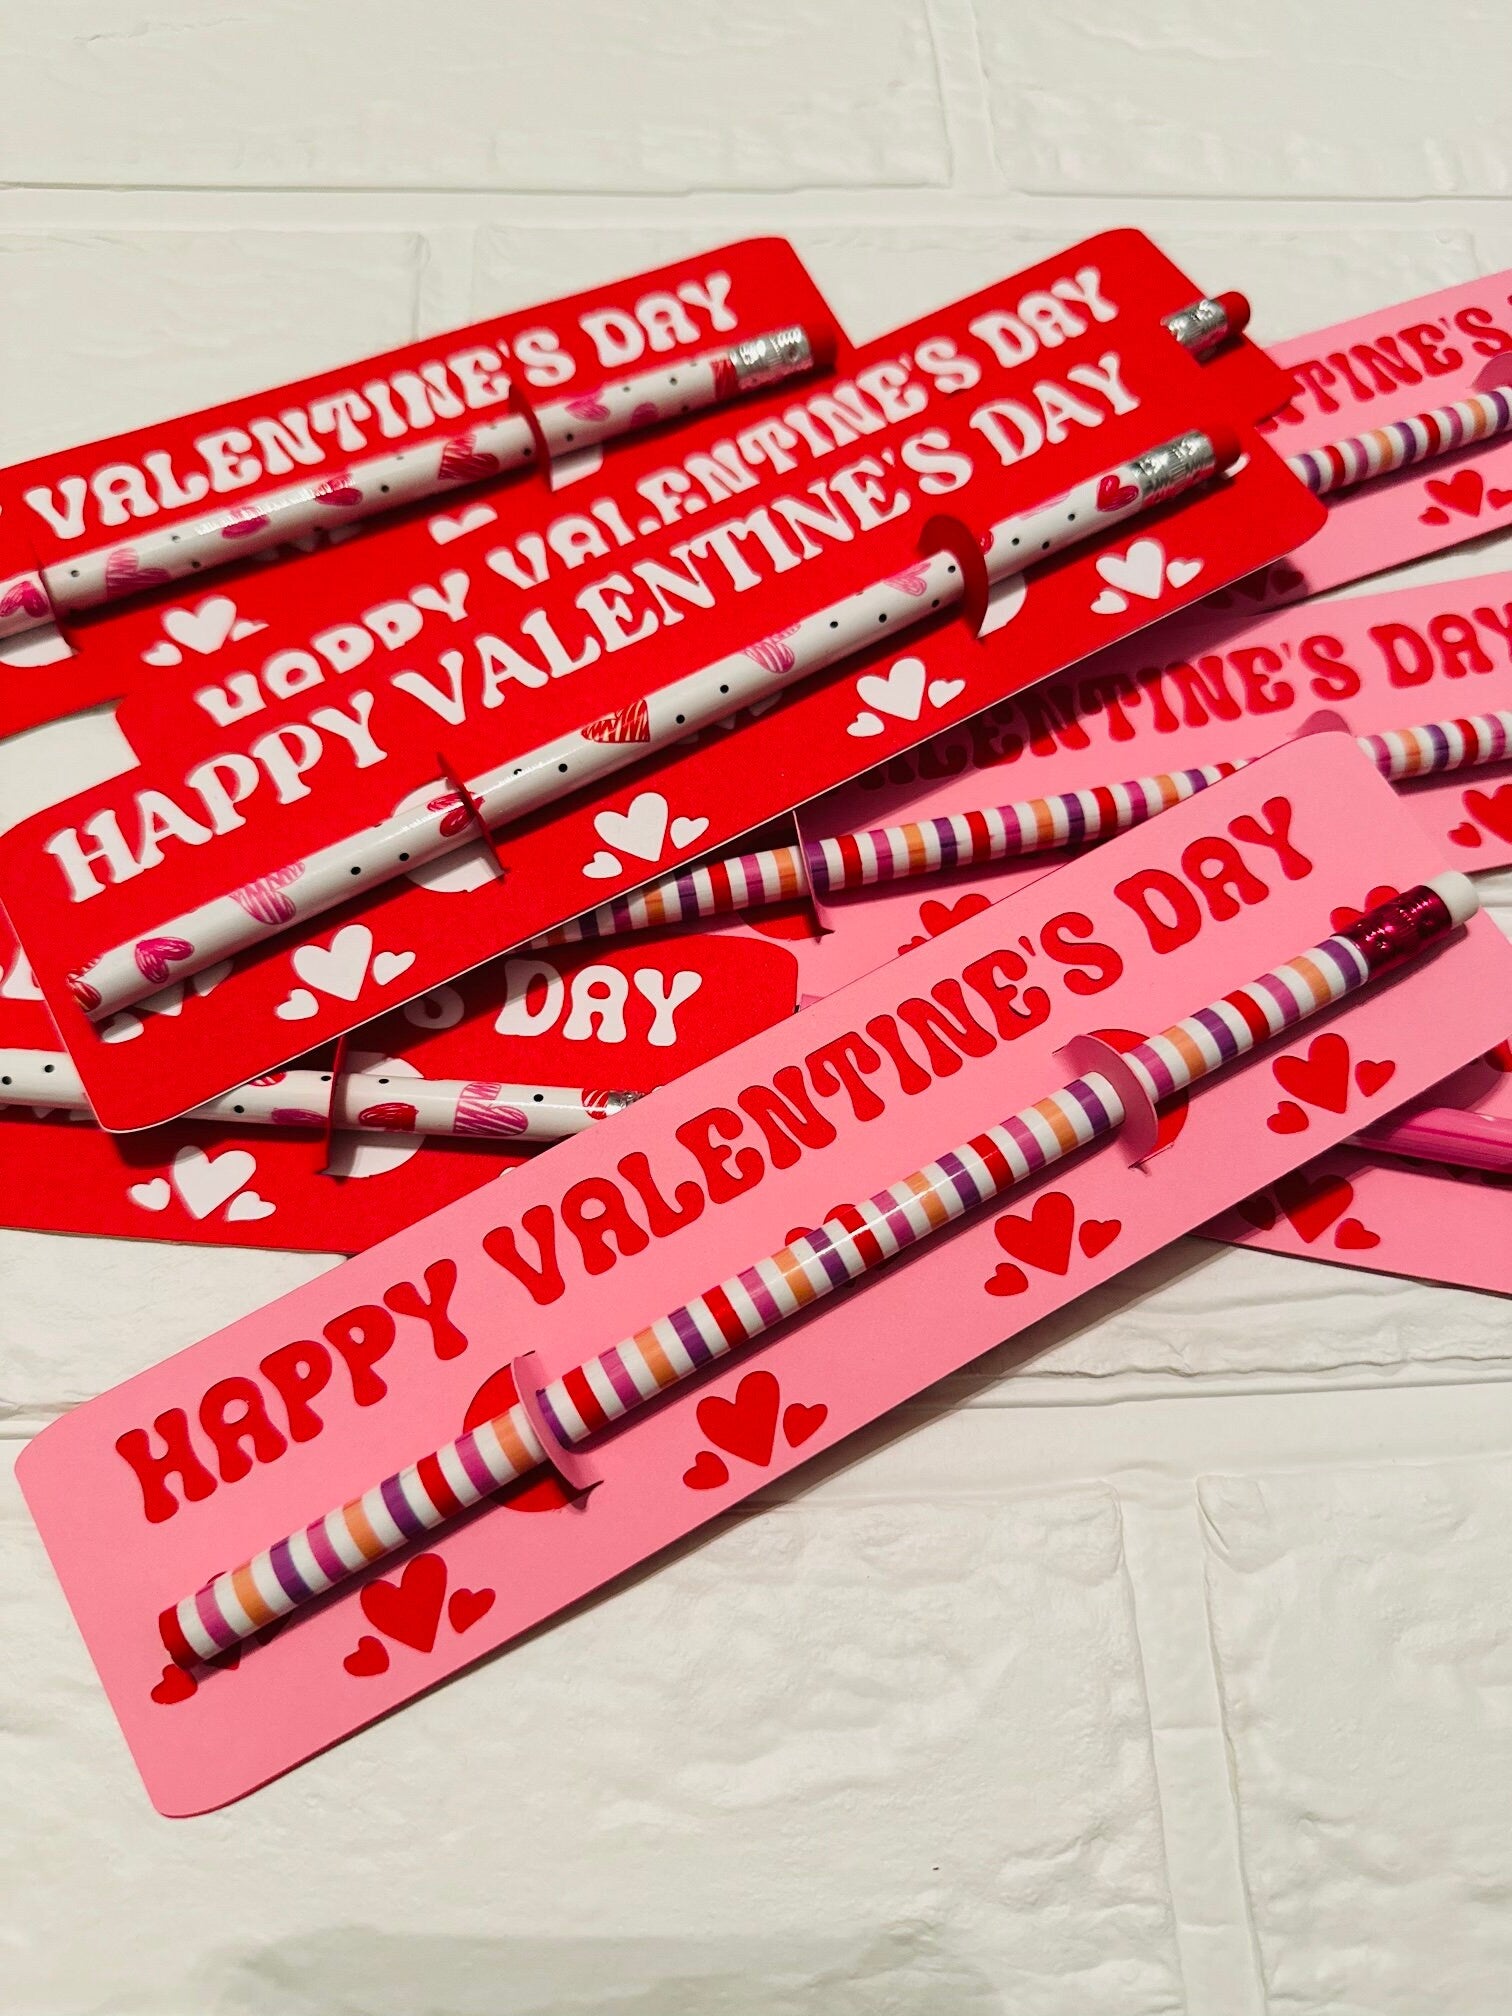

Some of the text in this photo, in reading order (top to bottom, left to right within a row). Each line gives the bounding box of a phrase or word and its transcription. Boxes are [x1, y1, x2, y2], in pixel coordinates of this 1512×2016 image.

[23, 272, 738, 540] VALENTINE'S DAY
[485, 338, 981, 591] VALENTINE'S
[968, 266, 1118, 369] DAY
[1256, 307, 1512, 434] TINE'S
[44, 352, 1140, 903] HAPPY VALENTINE'S DAY
[495, 959, 703, 1047] DAY
[114, 795, 1314, 1524] HAPPY VALENTINE'S DAY
